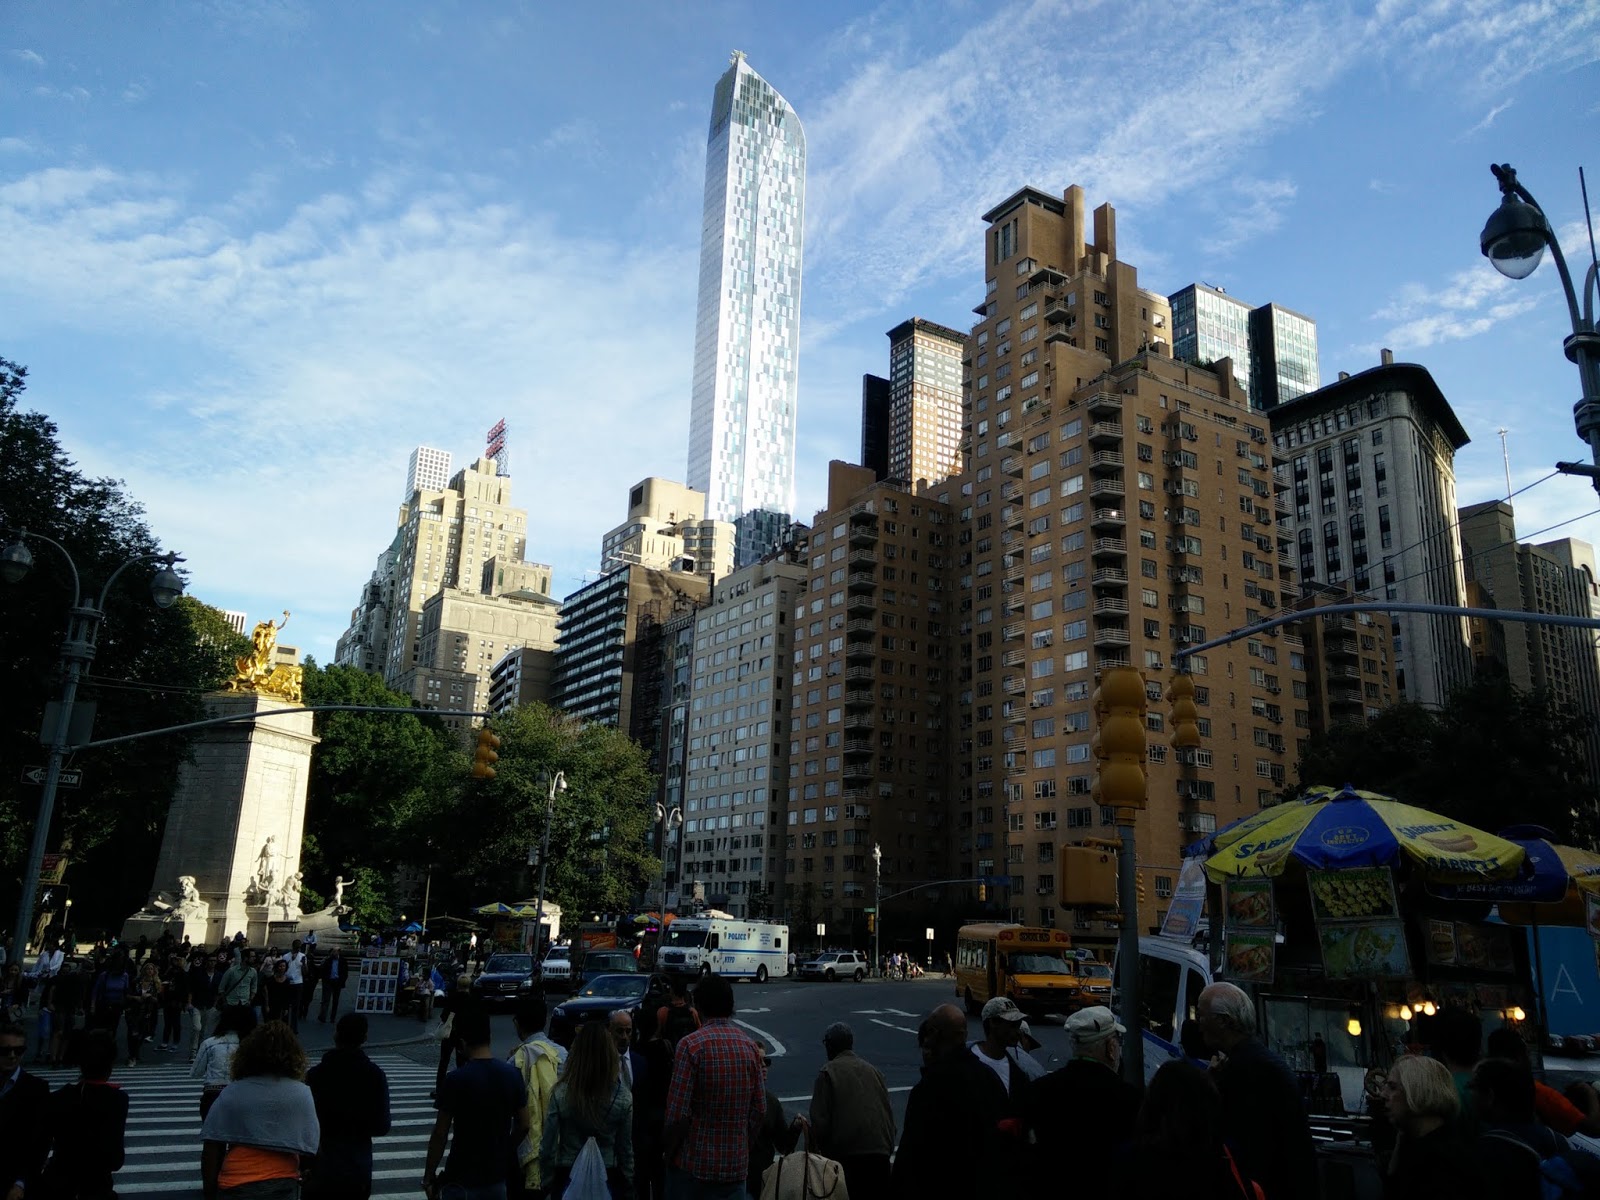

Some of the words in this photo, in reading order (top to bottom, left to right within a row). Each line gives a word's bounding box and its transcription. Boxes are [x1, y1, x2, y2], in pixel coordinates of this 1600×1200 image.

[1396, 824, 1456, 839] SABRETT
[1425, 856, 1501, 874] SABRETT
[728, 932, 746, 941] POLICE
[1551, 963, 1583, 1005] A
